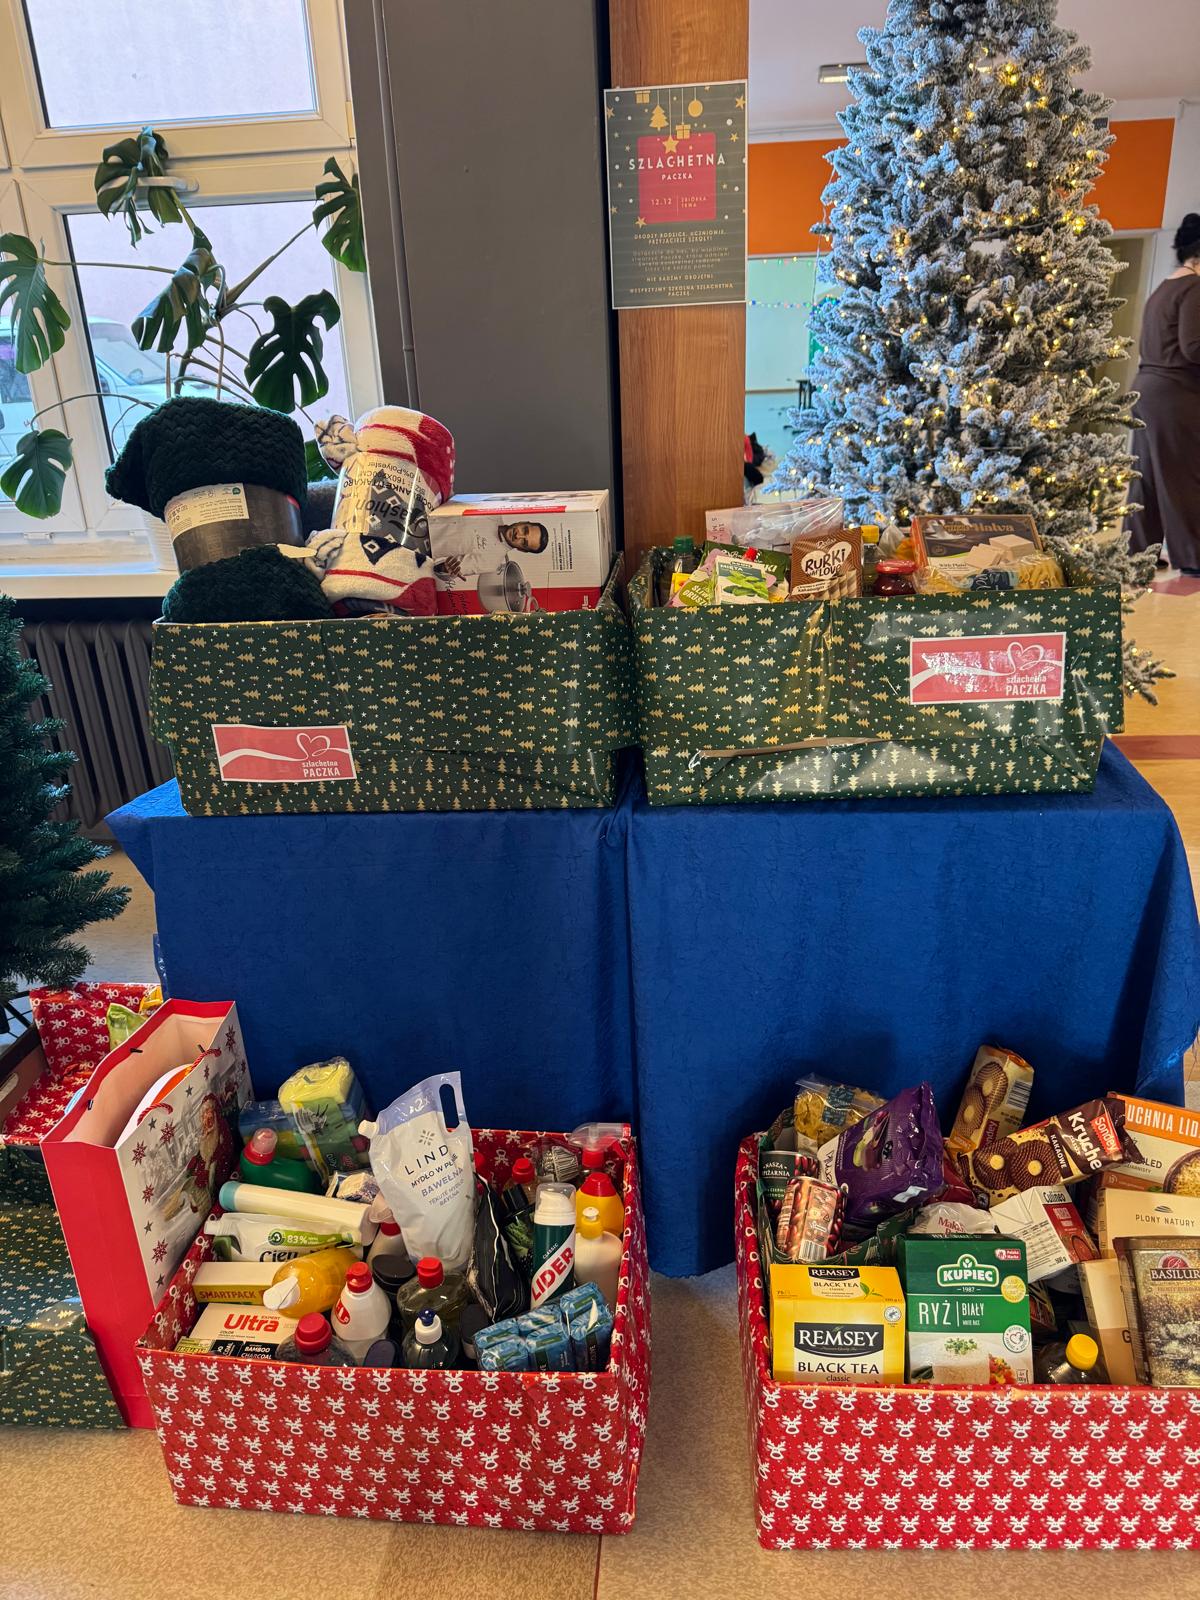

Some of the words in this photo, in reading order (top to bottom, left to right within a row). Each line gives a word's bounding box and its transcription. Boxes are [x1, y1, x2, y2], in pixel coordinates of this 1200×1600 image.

[629, 153, 725, 170] SZLACHETNA
[661, 172, 693, 181] PACZKA
[1006, 673, 1047, 683] szlachetna
[1005, 683, 1047, 696] PACZKA
[302, 759, 338, 767] szlachetna
[303, 767, 341, 777] PACZKA
[1127, 1103, 1174, 1132] UCHNIA
[1179, 1116, 1200, 1139] LID
[1067, 1111, 1103, 1170] Kruche
[1095, 1117, 1118, 1151] Sondey
[1050, 1134, 1067, 1169] KAKAOWE
[411, 1170, 435, 1188] MYDŁO
[421, 1167, 464, 1197] BAWEŁNA
[1135, 1214, 1161, 1223] PLONY
[1164, 1217, 1195, 1227] NATURY
[259, 1249, 299, 1263] Cien
[531, 1247, 574, 1302] LIDER
[811, 1269, 856, 1277] REMSEY
[943, 1269, 993, 1283] KUPIEC
[1151, 1269, 1200, 1280] BASILUR
[199, 1290, 257, 1299] SMARTPACK
[918, 1300, 951, 1326] RYŻ
[961, 1302, 985, 1317] BIAŁY
[223, 1313, 280, 1333] Ultra
[798, 1329, 880, 1347] REMSEY
[798, 1361, 846, 1374] BLACK
[850, 1363, 880, 1374] TEA
[826, 1373, 851, 1382] classic
